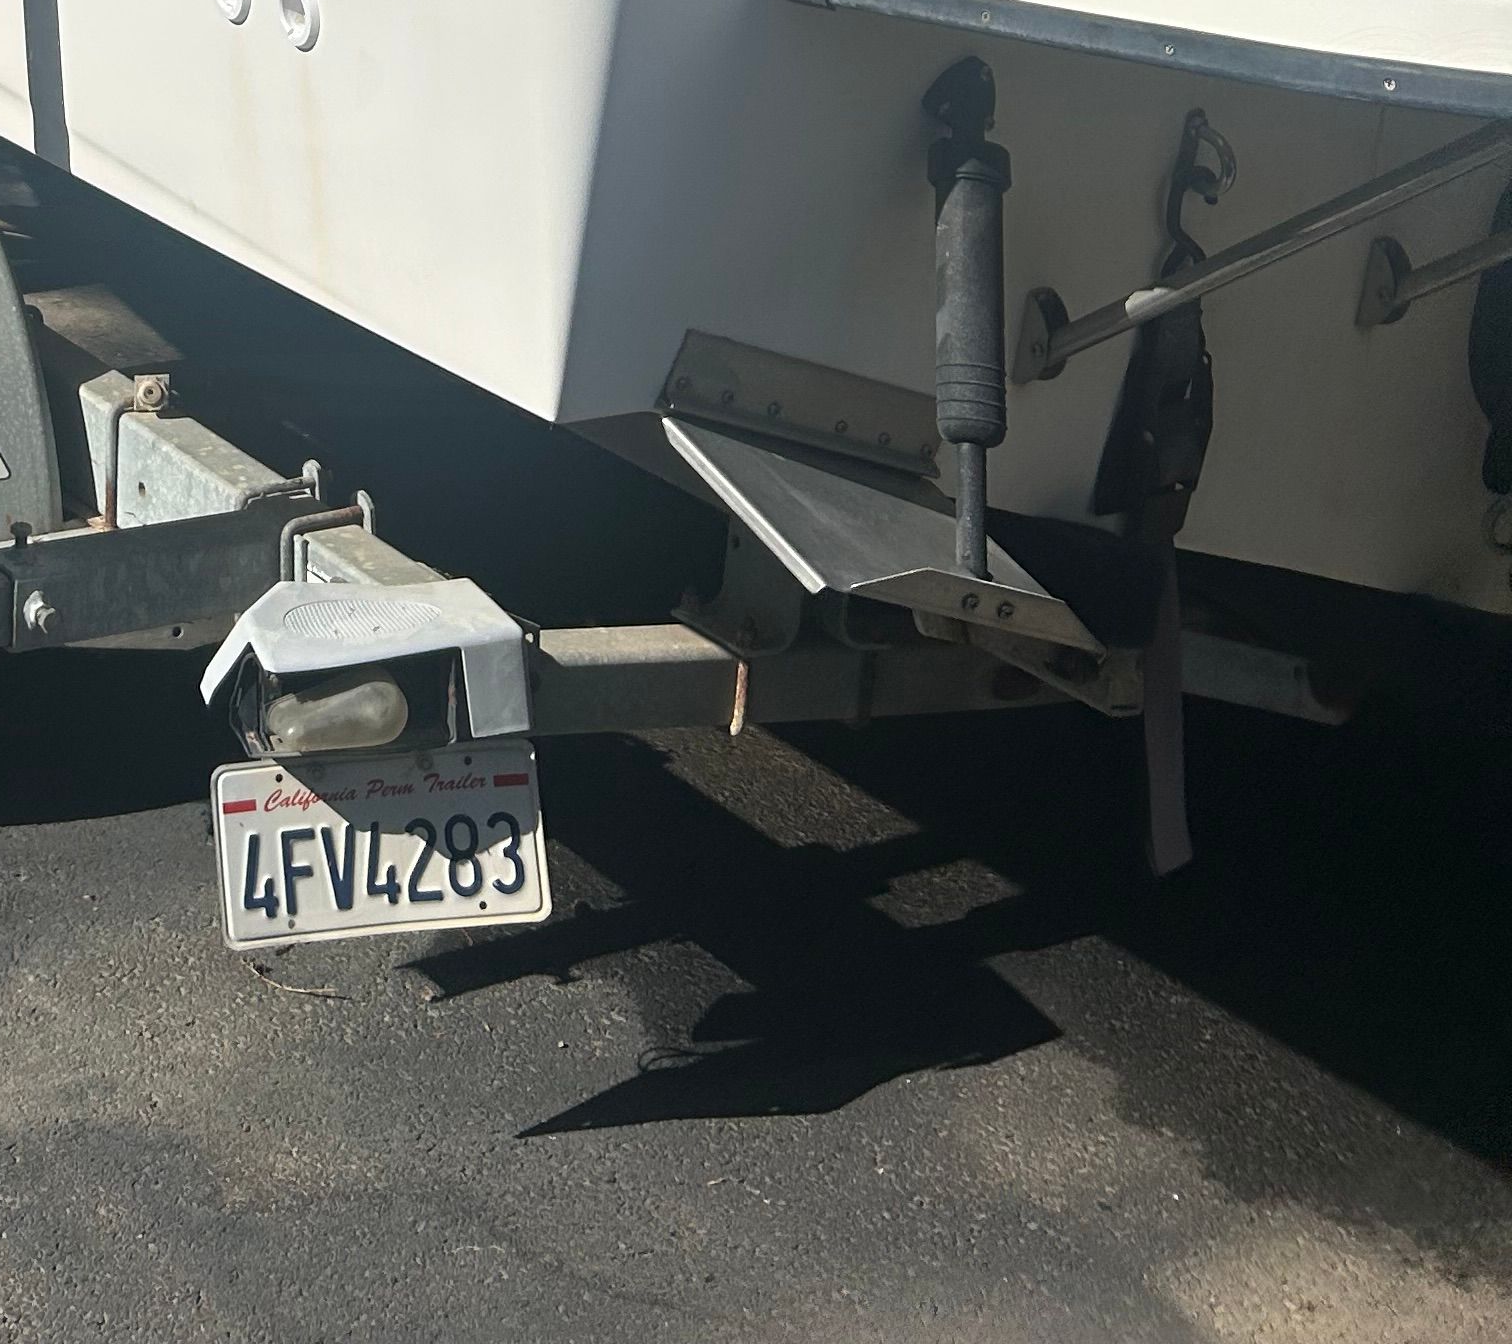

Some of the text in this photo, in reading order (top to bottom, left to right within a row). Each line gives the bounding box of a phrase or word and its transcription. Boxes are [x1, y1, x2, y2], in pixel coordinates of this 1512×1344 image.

[264, 772, 486, 812] California Perm Trailer
[243, 811, 526, 919] 4FV4283
